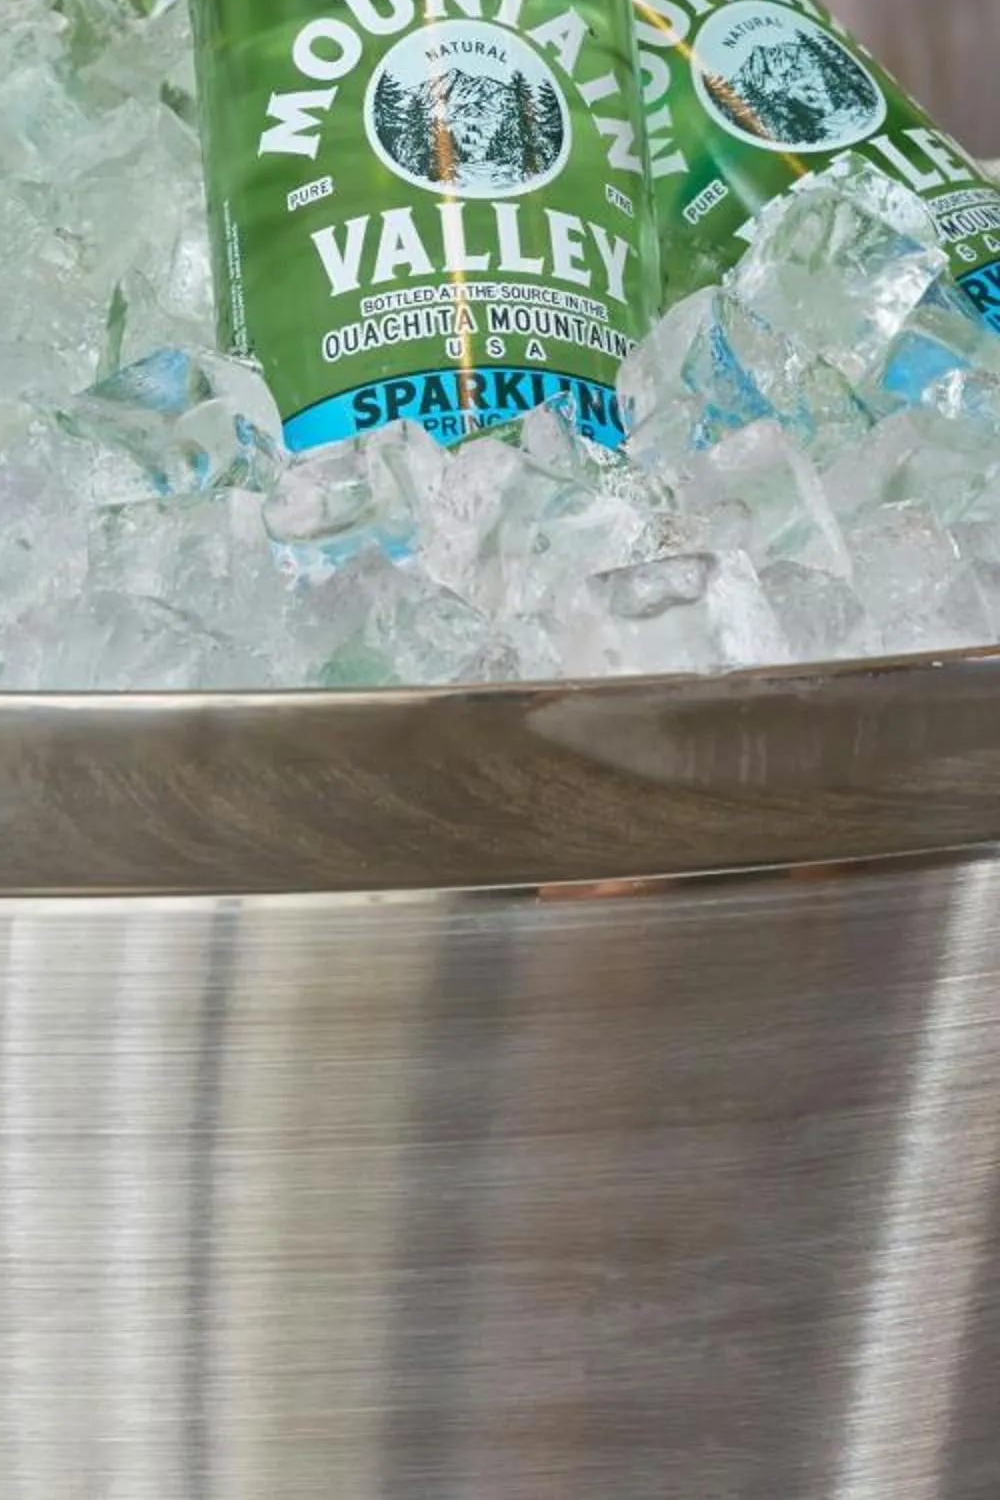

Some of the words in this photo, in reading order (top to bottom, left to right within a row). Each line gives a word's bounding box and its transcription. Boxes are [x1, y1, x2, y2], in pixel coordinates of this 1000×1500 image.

[722, 16, 784, 49] NATURAL
[425, 40, 506, 64] NATURAL
[288, 177, 332, 211] PURE
[684, 180, 728, 224] PURE
[311, 201, 635, 304] VALLEY
[363, 288, 435, 313] BOTTLED
[440, 285, 459, 300] AT
[467, 285, 496, 299] THE
[501, 285, 561, 306] SOURCE
[565, 296, 579, 310] IN
[580, 299, 607, 320] THE
[325, 307, 475, 359] OUACHITA
